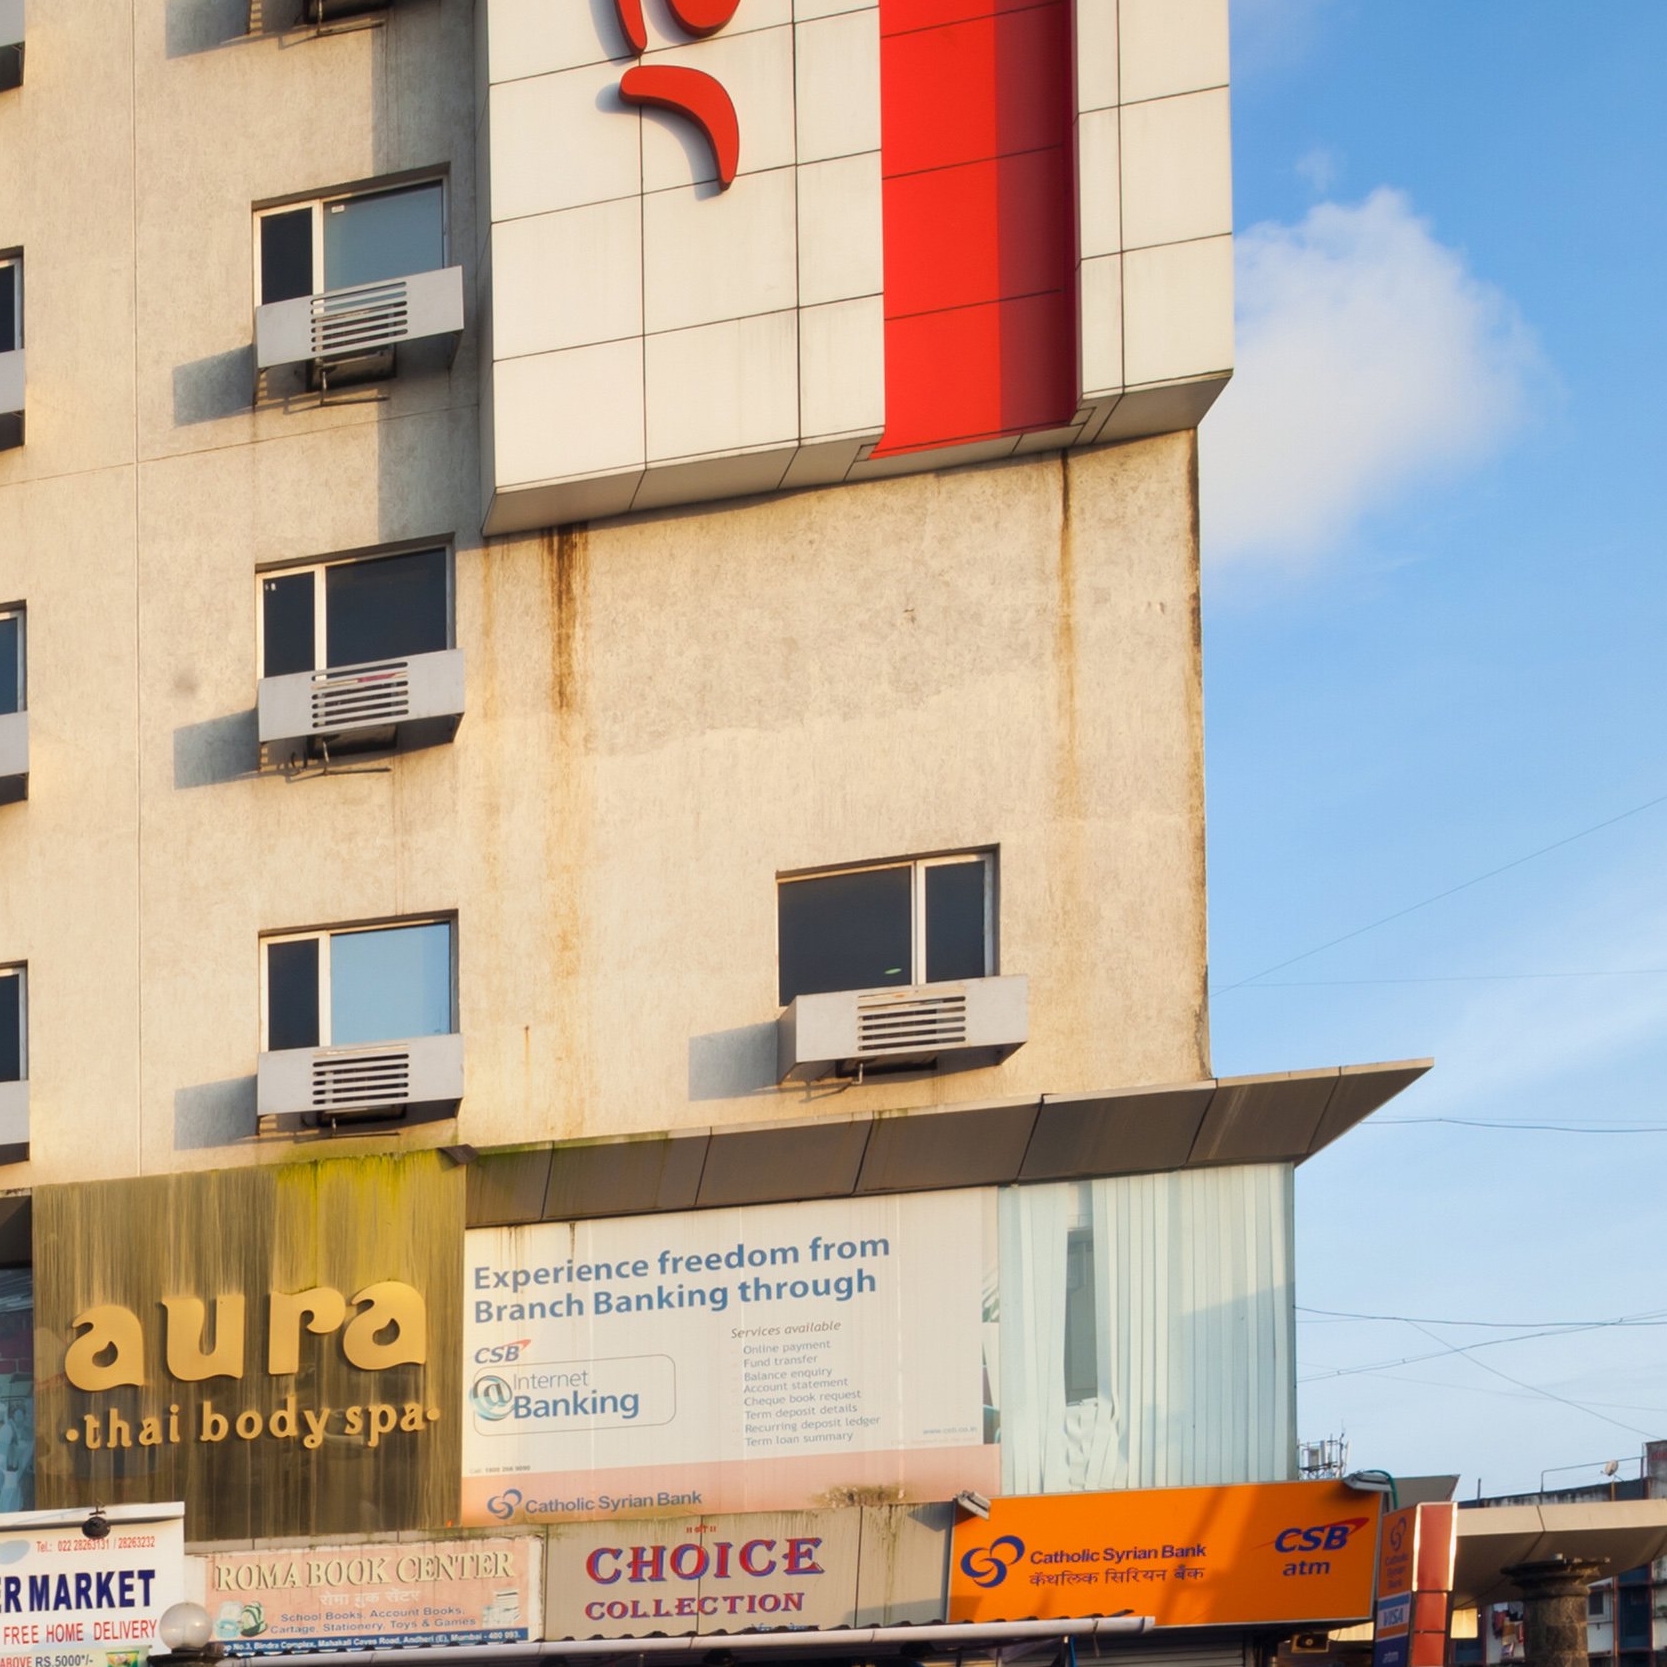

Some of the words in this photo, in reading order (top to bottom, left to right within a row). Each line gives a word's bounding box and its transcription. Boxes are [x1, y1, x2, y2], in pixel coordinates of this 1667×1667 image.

[474, 1258, 649, 1295] Experience
[658, 1244, 799, 1275] freedom
[810, 1236, 890, 1261] from
[474, 1294, 584, 1323] Branch
[593, 1285, 729, 1315] Banking
[738, 1268, 877, 1304] through
[65, 1282, 427, 1392] aura
[731, 1326, 781, 1339] Services
[784, 1320, 841, 1335] available
[474, 1345, 520, 1365] CSB
[743, 1343, 779, 1355] Online
[782, 1340, 831, 1353] payment
[744, 1358, 771, 1368] Fund
[774, 1354, 818, 1367] transfer
[513, 1369, 589, 1391] Internet
[513, 1389, 640, 1420] Banking
[745, 1410, 772, 1420] Term
[775, 1406, 815, 1419] deposit
[819, 1403, 858, 1414] details
[83, 1404, 180, 1450] thai
[201, 1398, 326, 1449] body
[347, 1403, 425, 1445] spa
[525, 1496, 595, 1515] Catholic
[598, 1493, 654, 1514] Syrian
[657, 1491, 702, 1506] Bank
[57, 1539, 72, 1552] 022
[118, 1536, 155, 1549] 28263232
[1275, 1526, 1349, 1553] CSB
[586, 1538, 824, 1585] CHOICE
[1030, 1548, 1100, 1565] Catholic
[1103, 1546, 1158, 1564] Syrian
[1162, 1544, 1206, 1559] Bank
[216, 1562, 303, 1591] ROMA
[307, 1556, 392, 1587] BOOK
[396, 1551, 516, 1583] CENTER
[1283, 1561, 1330, 1576] atm
[30, 1569, 155, 1612] MARKET
[280, 1613, 321, 1622] School
[370, 1608, 419, 1619] Account
[586, 1593, 804, 1620] COLLECTION
[1383, 1608, 1403, 1627] VISA
[3, 1625, 40, 1645] FREE
[46, 1623, 83, 1643] HOME
[93, 1619, 157, 1640] DELIVERY
[390, 1619, 417, 1630] Toys
[434, 1616, 476, 1626] Games
